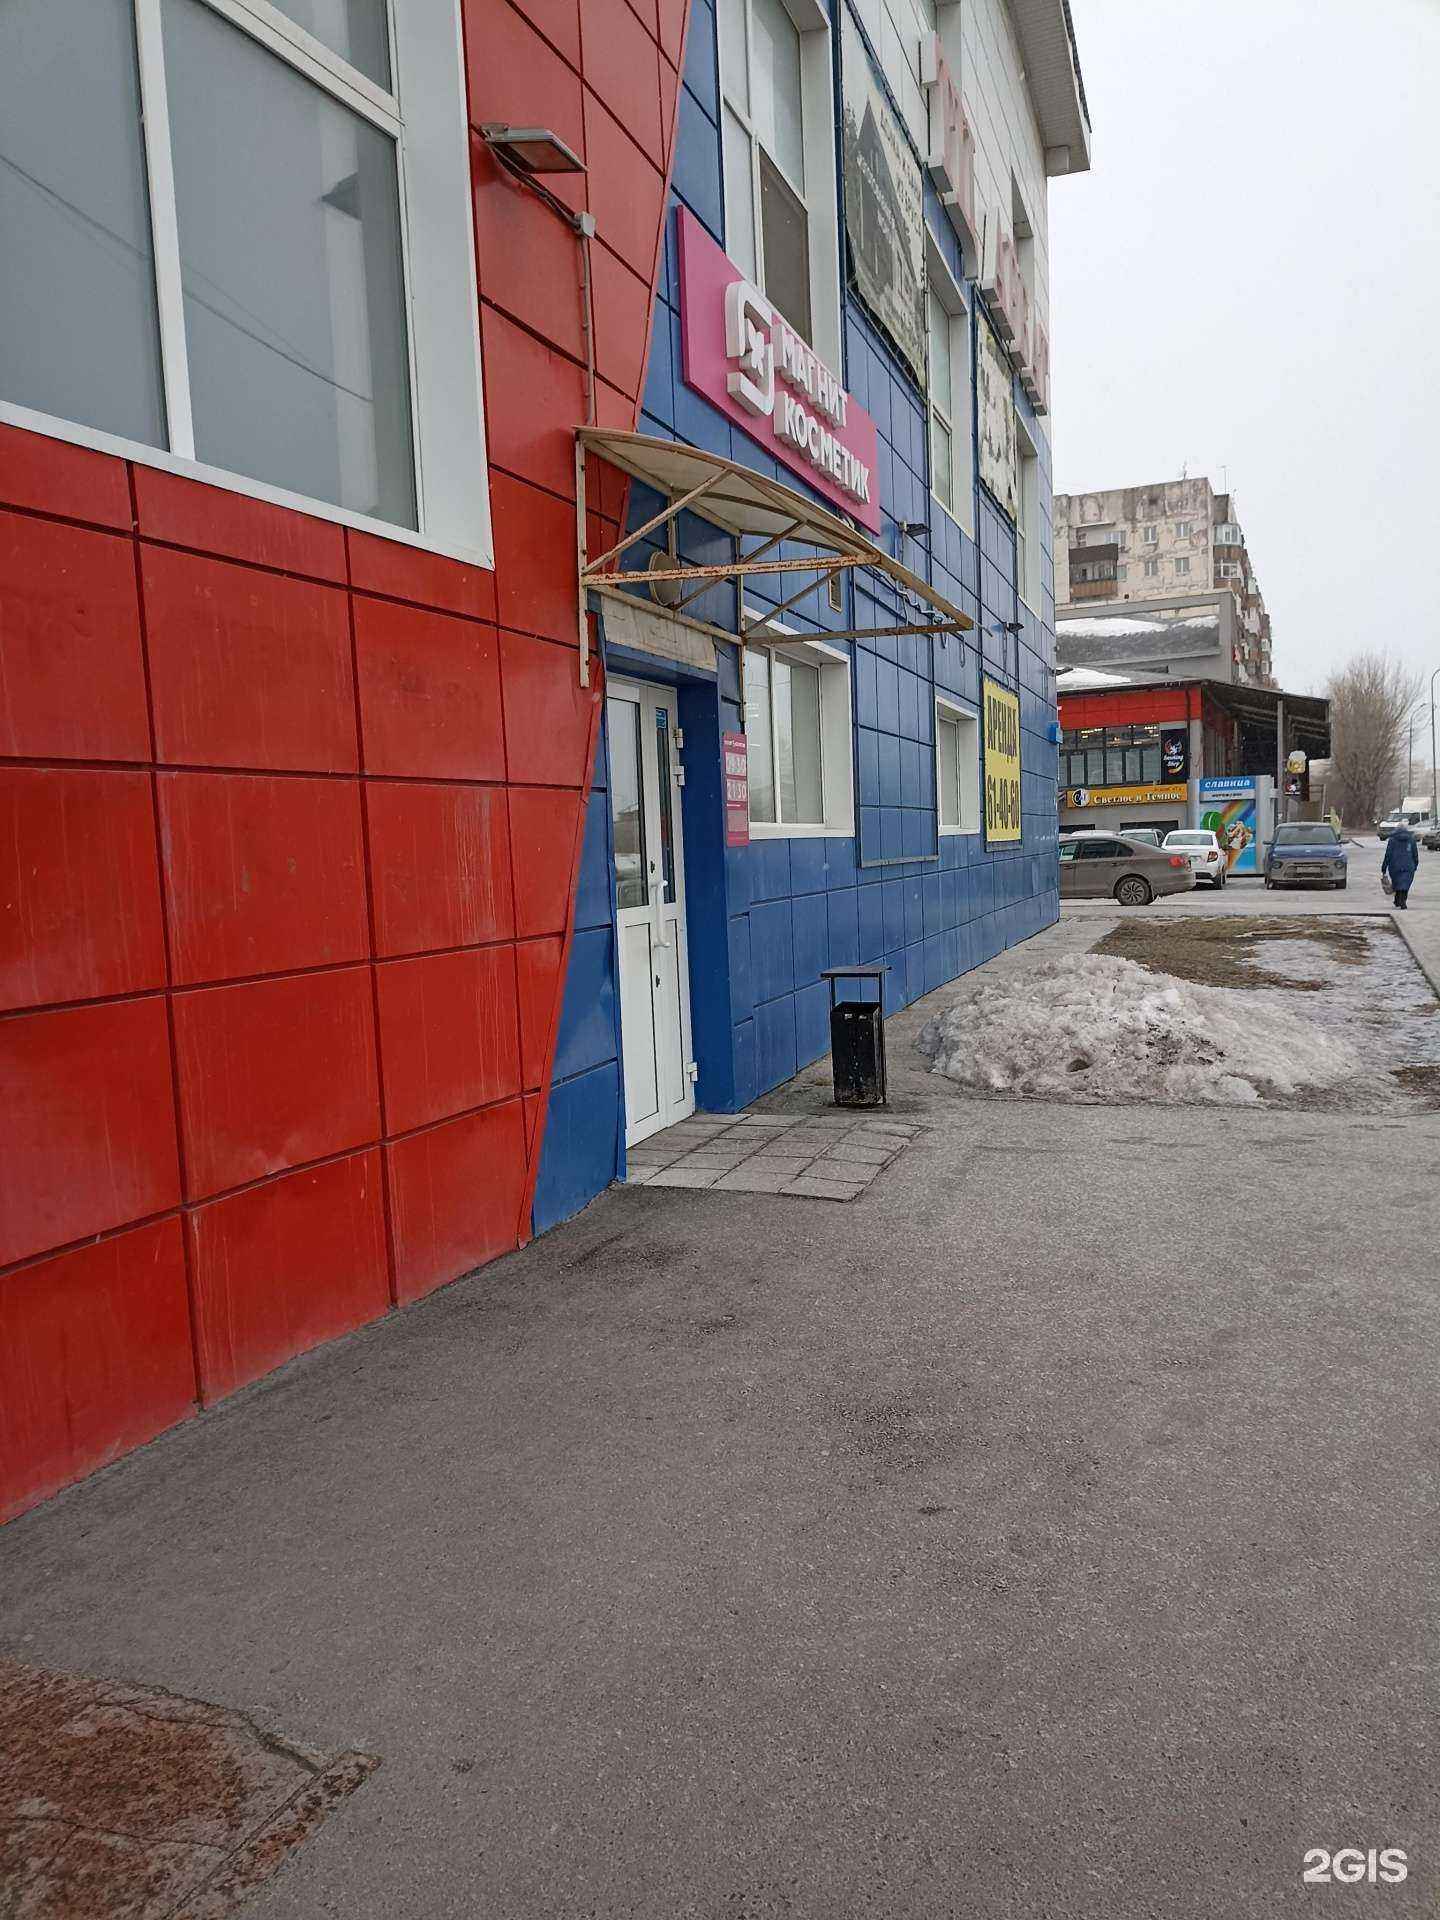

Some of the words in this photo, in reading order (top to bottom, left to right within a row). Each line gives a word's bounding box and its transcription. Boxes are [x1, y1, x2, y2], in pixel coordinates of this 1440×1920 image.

[778, 323, 848, 428] МАГНИТ
[777, 391, 870, 503] КОСМЕТИК
[987, 694, 1017, 762] АРЕНДА
[1094, 794, 1133, 805] Светлое
